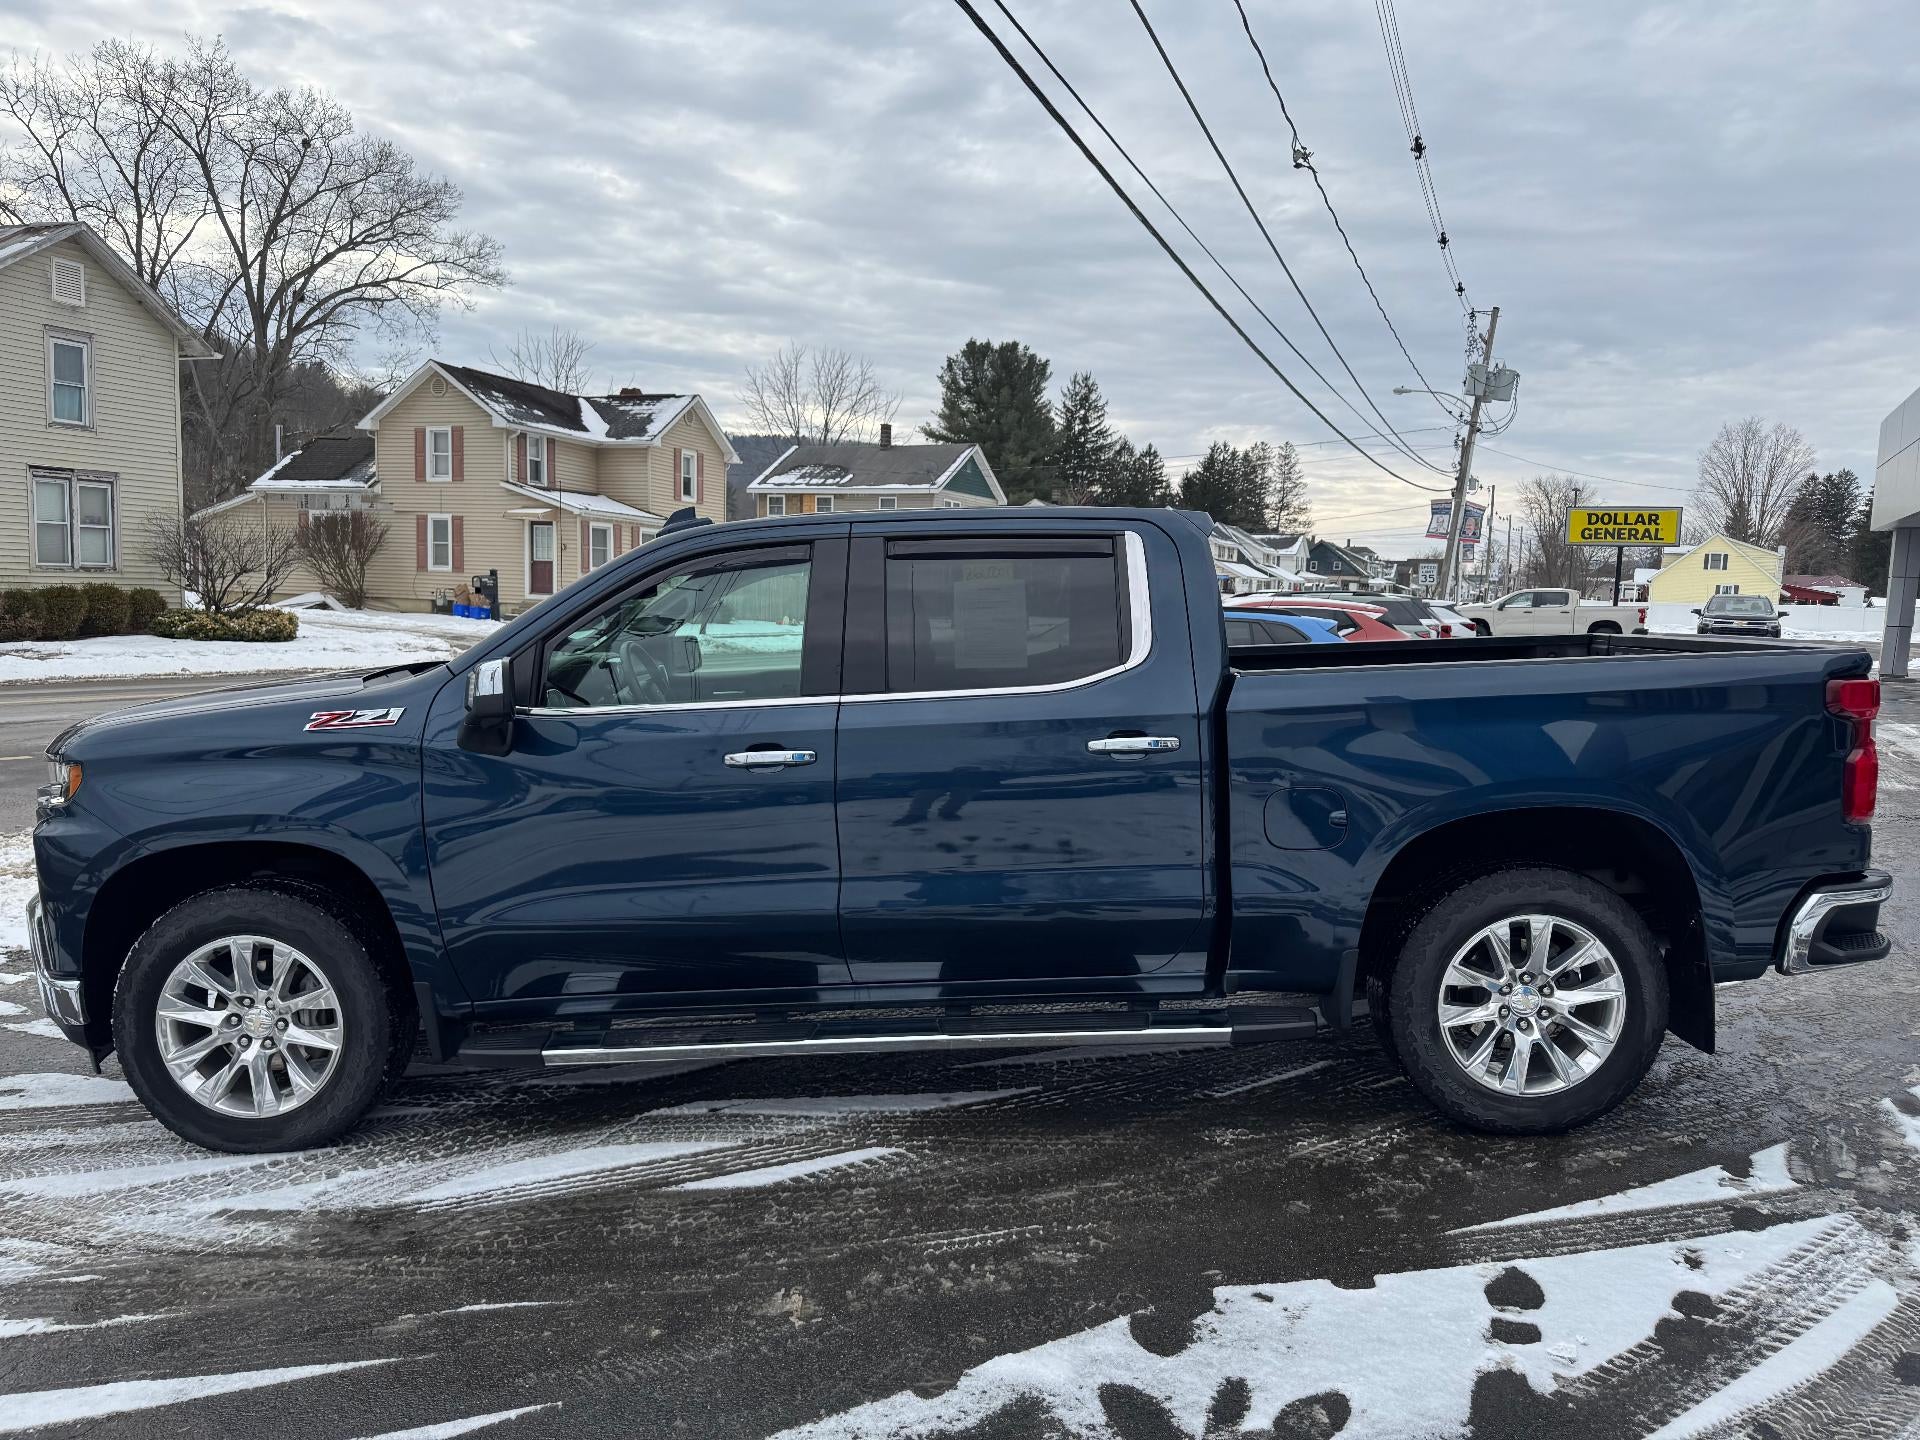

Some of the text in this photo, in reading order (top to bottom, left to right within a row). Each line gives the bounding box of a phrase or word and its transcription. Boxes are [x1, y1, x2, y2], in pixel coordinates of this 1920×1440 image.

[1587, 512, 1660, 526] DOLLAR
[1581, 527, 1664, 541] GENERAL
[1421, 574, 1435, 583] 35
[303, 706, 407, 732] Z71
